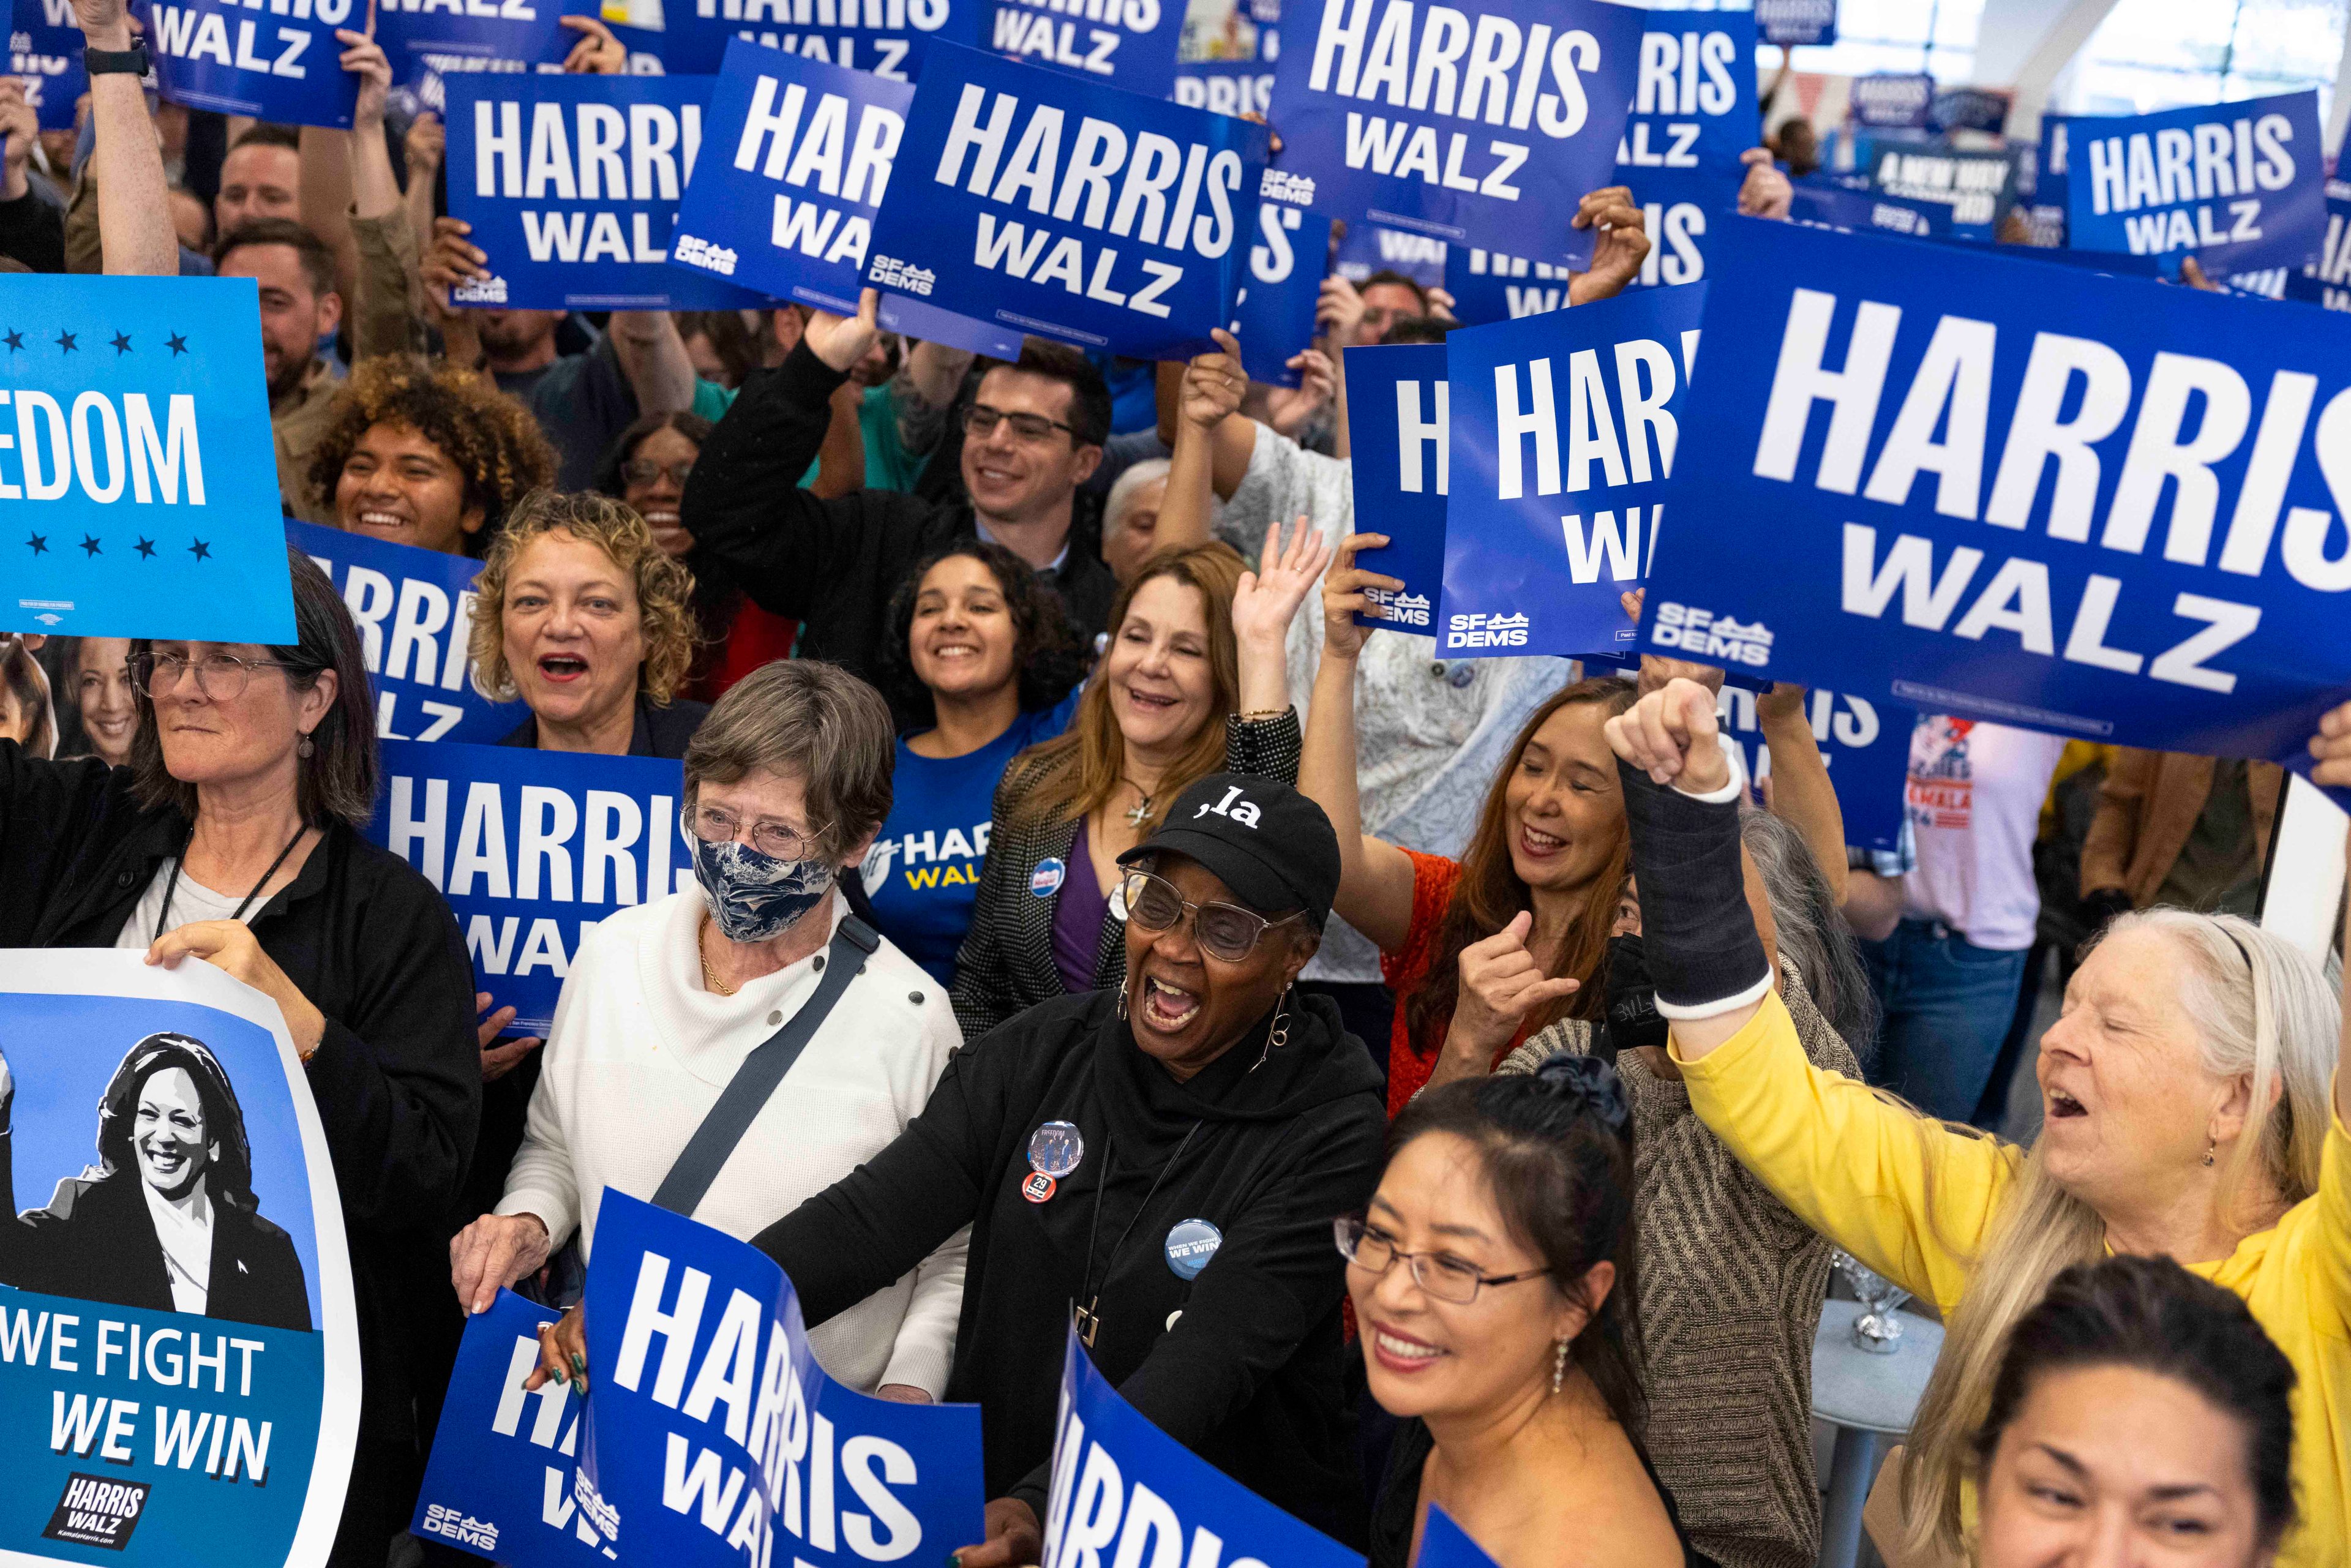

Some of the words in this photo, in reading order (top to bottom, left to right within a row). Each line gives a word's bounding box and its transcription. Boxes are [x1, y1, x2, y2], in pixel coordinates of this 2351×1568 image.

[152, 3, 312, 80] WALZ
[993, 7, 1120, 75] WALZ
[1308, 0, 1600, 139] HARRIS
[1628, 31, 1737, 116] RIS
[474, 100, 702, 200] HARRI
[735, 75, 906, 208] HAR
[1346, 111, 1530, 201] WALZ
[1616, 122, 1701, 168] LZ
[2089, 114, 2296, 216] HARRIS
[935, 82, 1243, 260] HARRIS
[521, 211, 678, 263] WAL
[771, 193, 872, 271] WA
[2124, 199, 2263, 255] WALZ
[674, 247, 736, 276] DEMS
[868, 269, 933, 296] DEMS
[873, 254, 904, 274] SF
[973, 212, 1183, 318] WALZ
[1494, 328, 1702, 500] HAR
[309, 555, 493, 700] RRI
[1364, 606, 1430, 626] EMS
[1450, 614, 1487, 631] SF
[1657, 602, 1712, 629] SF
[1842, 522, 2262, 694] WALZ
[1447, 629, 1528, 648] DEMS
[1651, 623, 1772, 667] DEMS
[377, 691, 463, 742] LZ
[905, 863, 980, 890] WAL
[455, 913, 600, 978] WA
[1033, 1177, 1048, 1190] 29
[1169, 1247, 1190, 1258] WE
[1192, 1241, 1220, 1254] WIN
[0, 1306, 81, 1373] WE
[96, 1319, 265, 1398] FIGHT
[613, 1250, 923, 1562] HARRIS
[51, 1390, 140, 1461] WE
[155, 1405, 273, 1482] WIN
[63, 1478, 144, 1518] HARRIS
[67, 1510, 122, 1534] WALZ
[427, 1504, 463, 1523] SF
[662, 1431, 824, 1568] WA
[57, 1529, 114, 1545] KamalaHarris.com
[422, 1516, 497, 1551] DEMS
